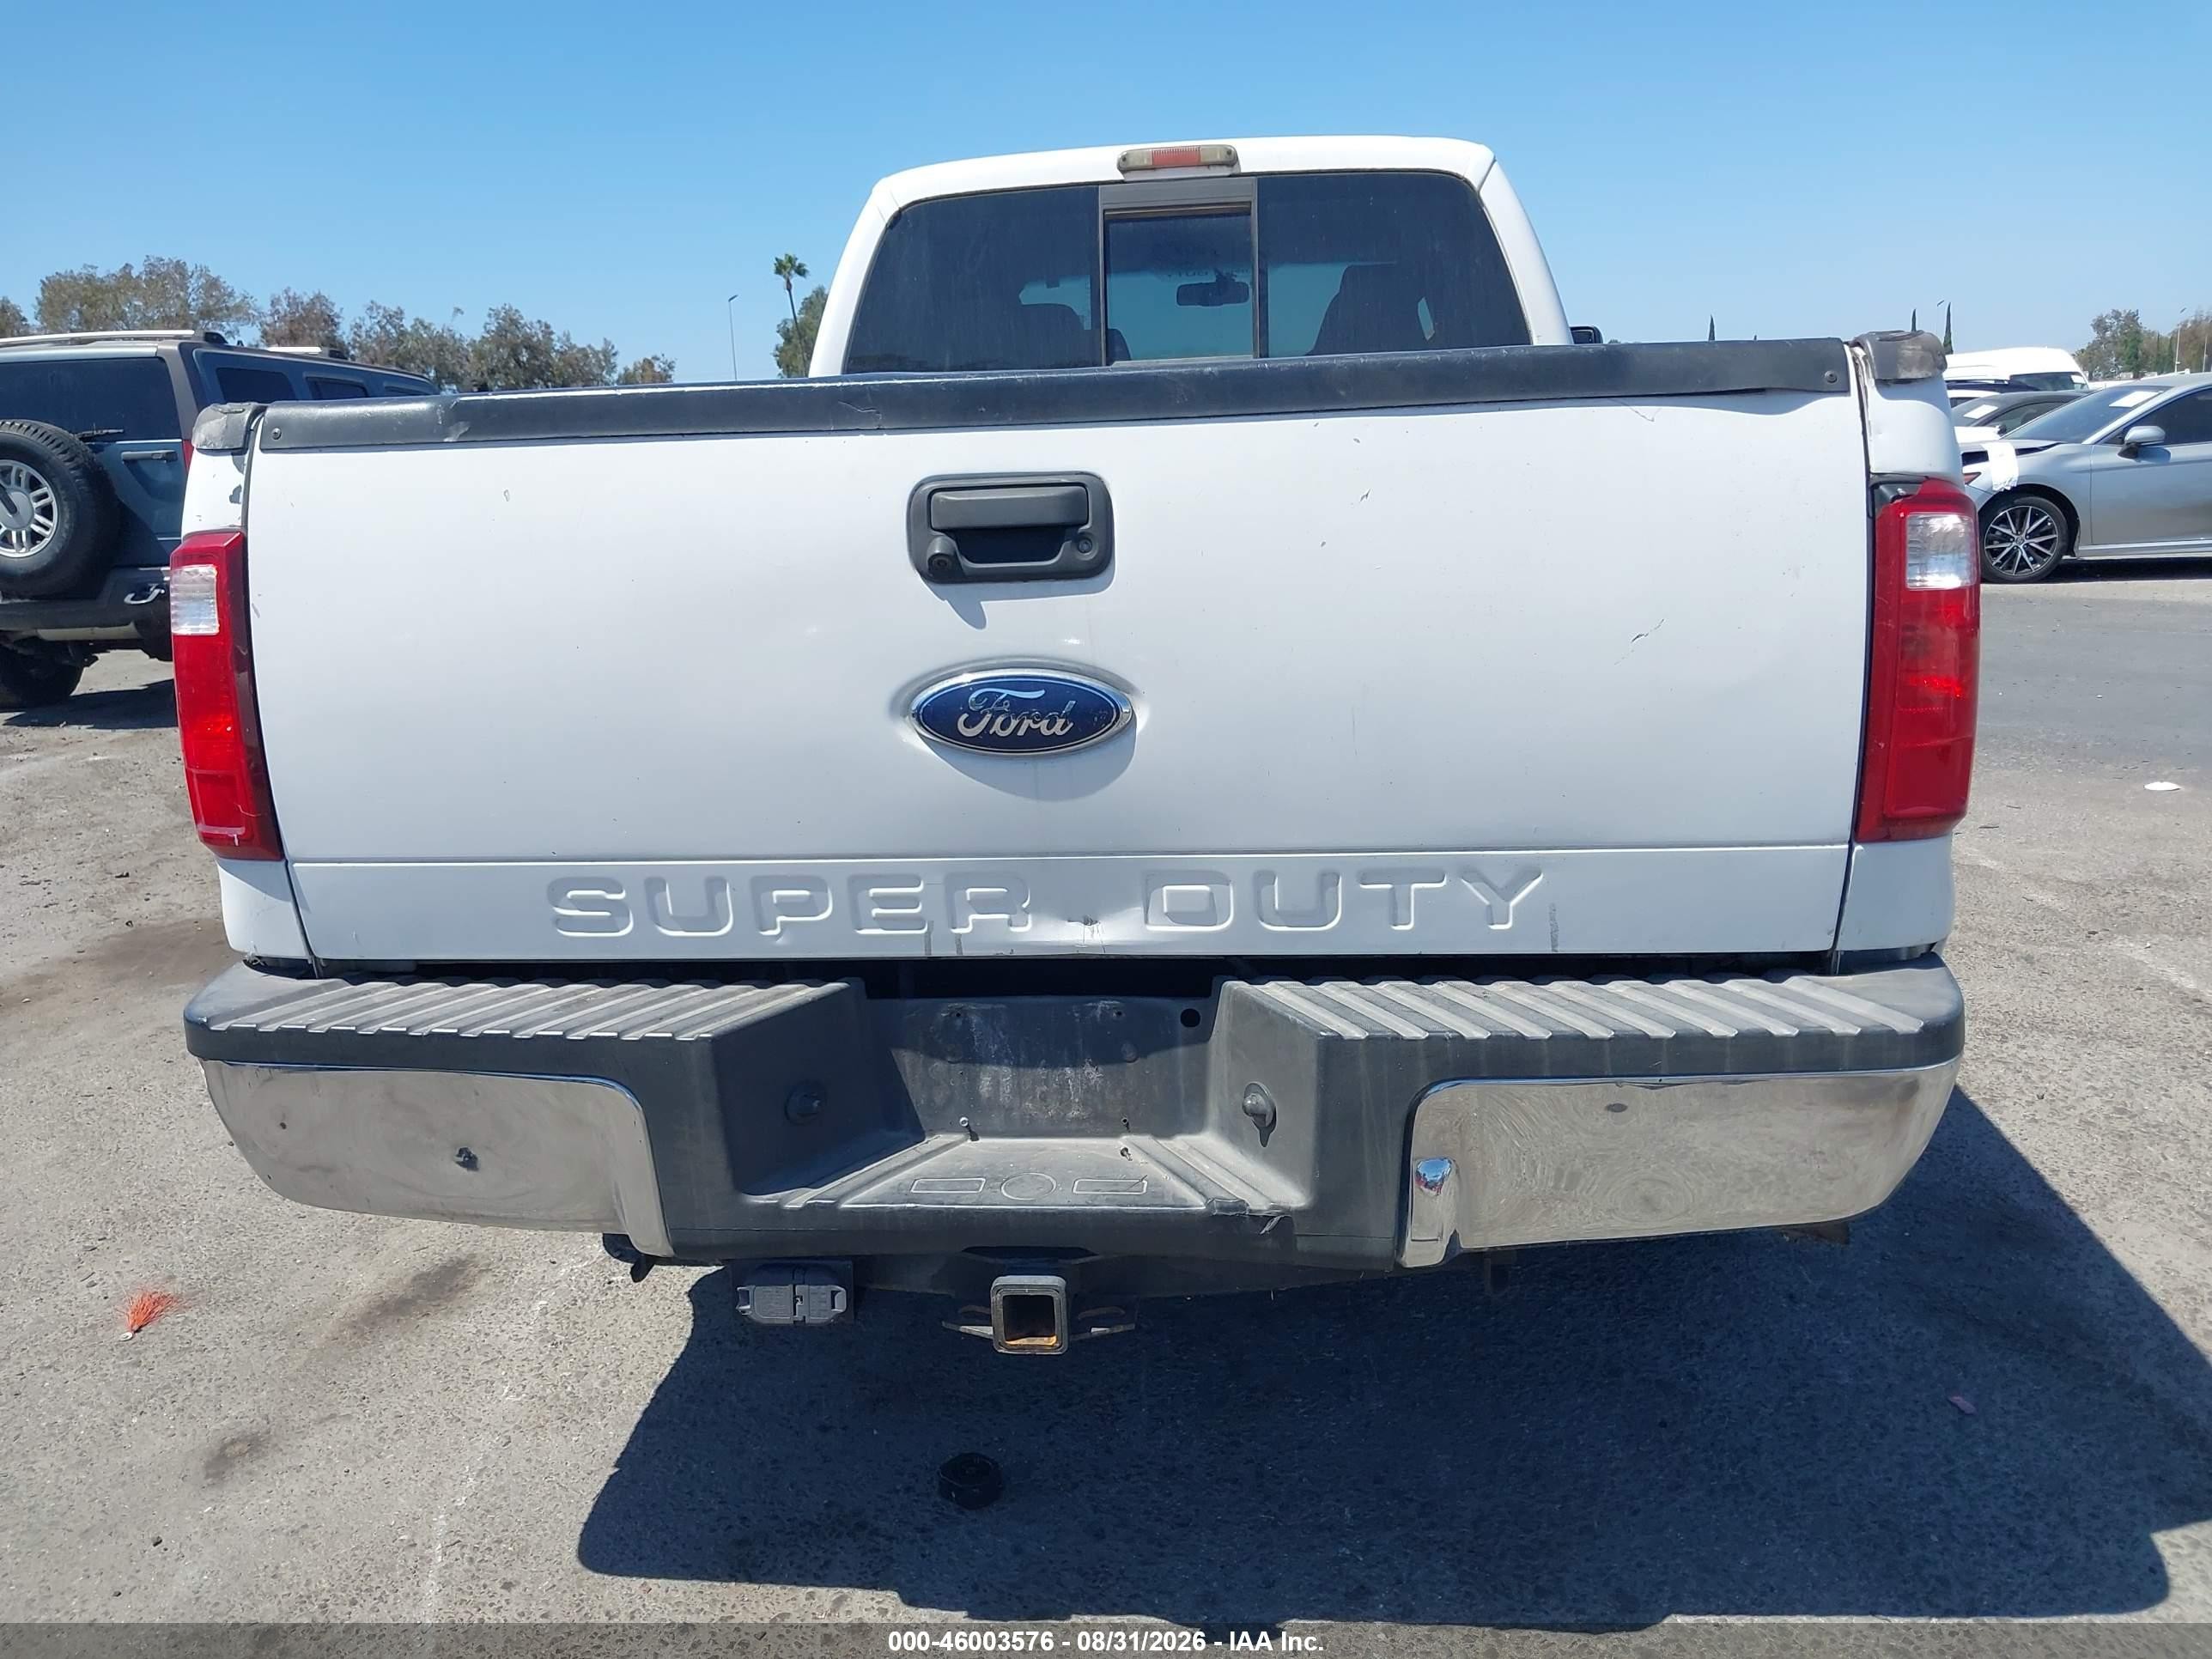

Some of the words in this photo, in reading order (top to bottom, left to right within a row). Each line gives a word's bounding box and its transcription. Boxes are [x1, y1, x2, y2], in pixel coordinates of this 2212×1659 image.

[957, 687, 1076, 738] Ford
[547, 872, 1032, 938] SUPER
[1143, 868, 1544, 932] DUTY
